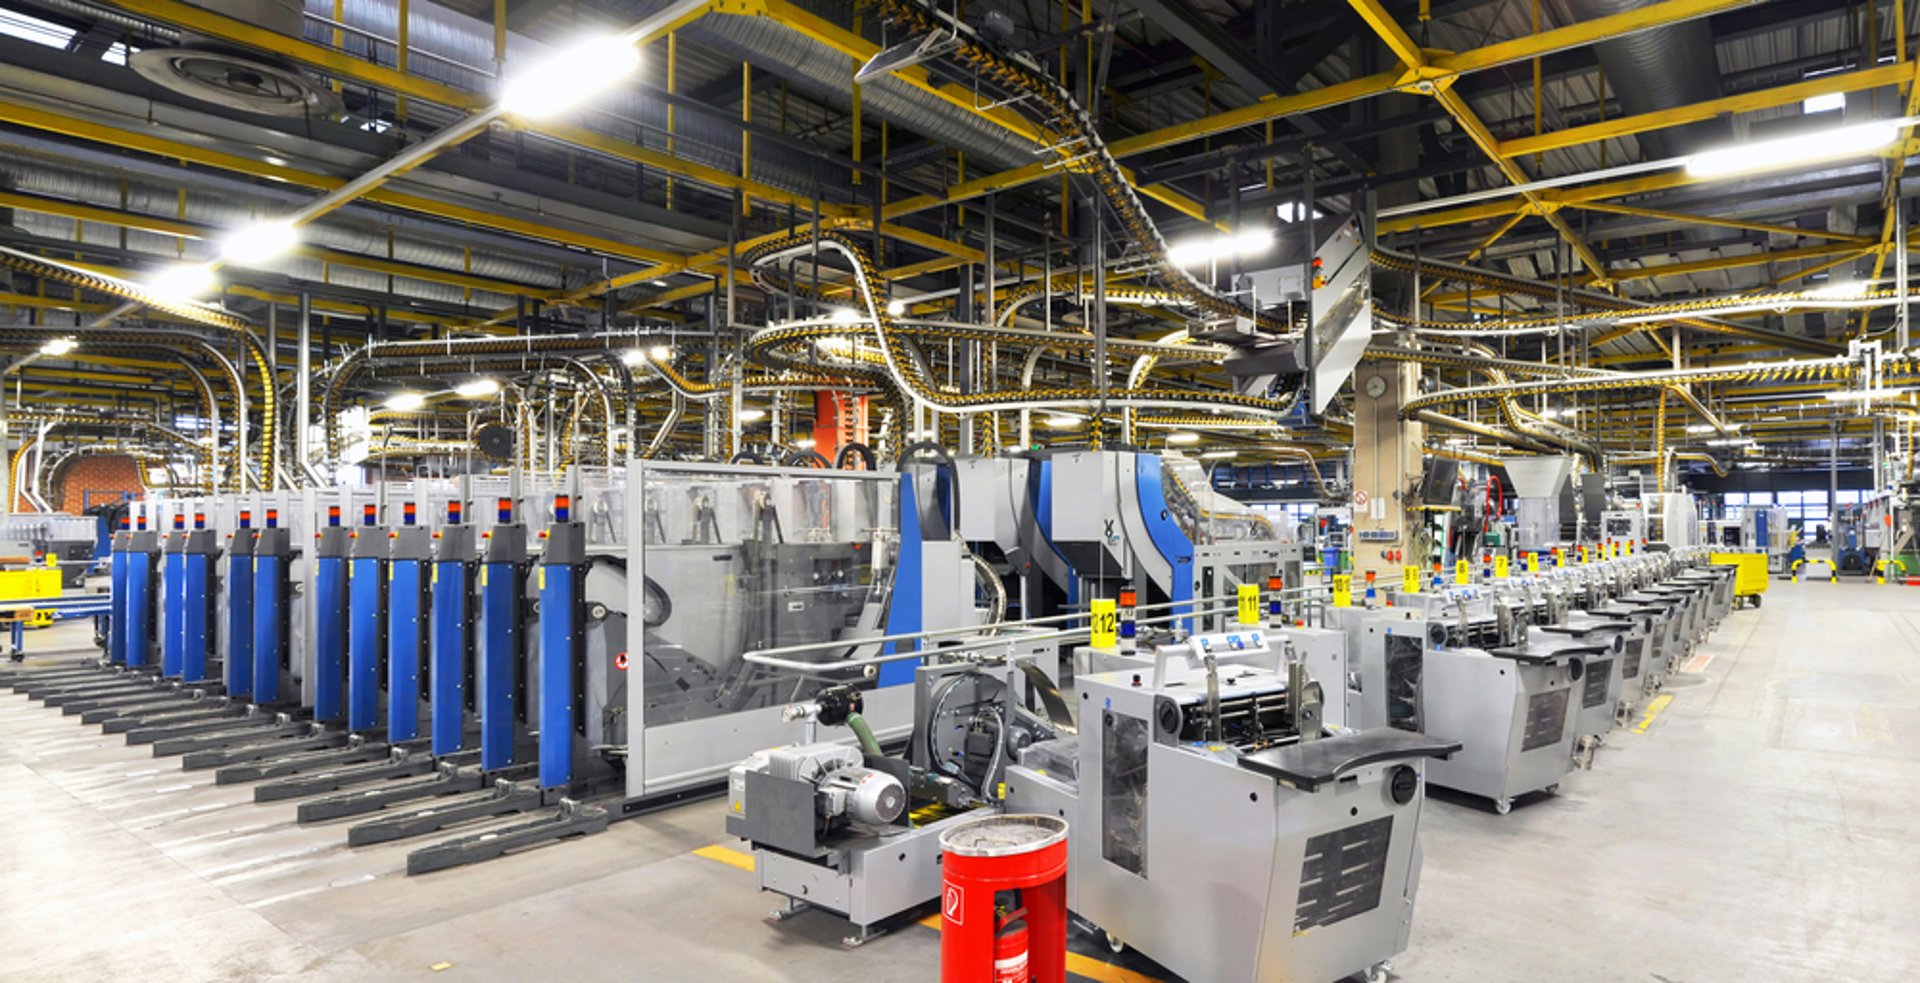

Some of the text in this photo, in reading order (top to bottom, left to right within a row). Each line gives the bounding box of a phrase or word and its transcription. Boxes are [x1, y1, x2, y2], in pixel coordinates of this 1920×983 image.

[1459, 563, 1466, 575] 8
[1497, 558, 1504, 568] 7
[1248, 595, 1257, 611] 11
[1100, 612, 1114, 634] 12
